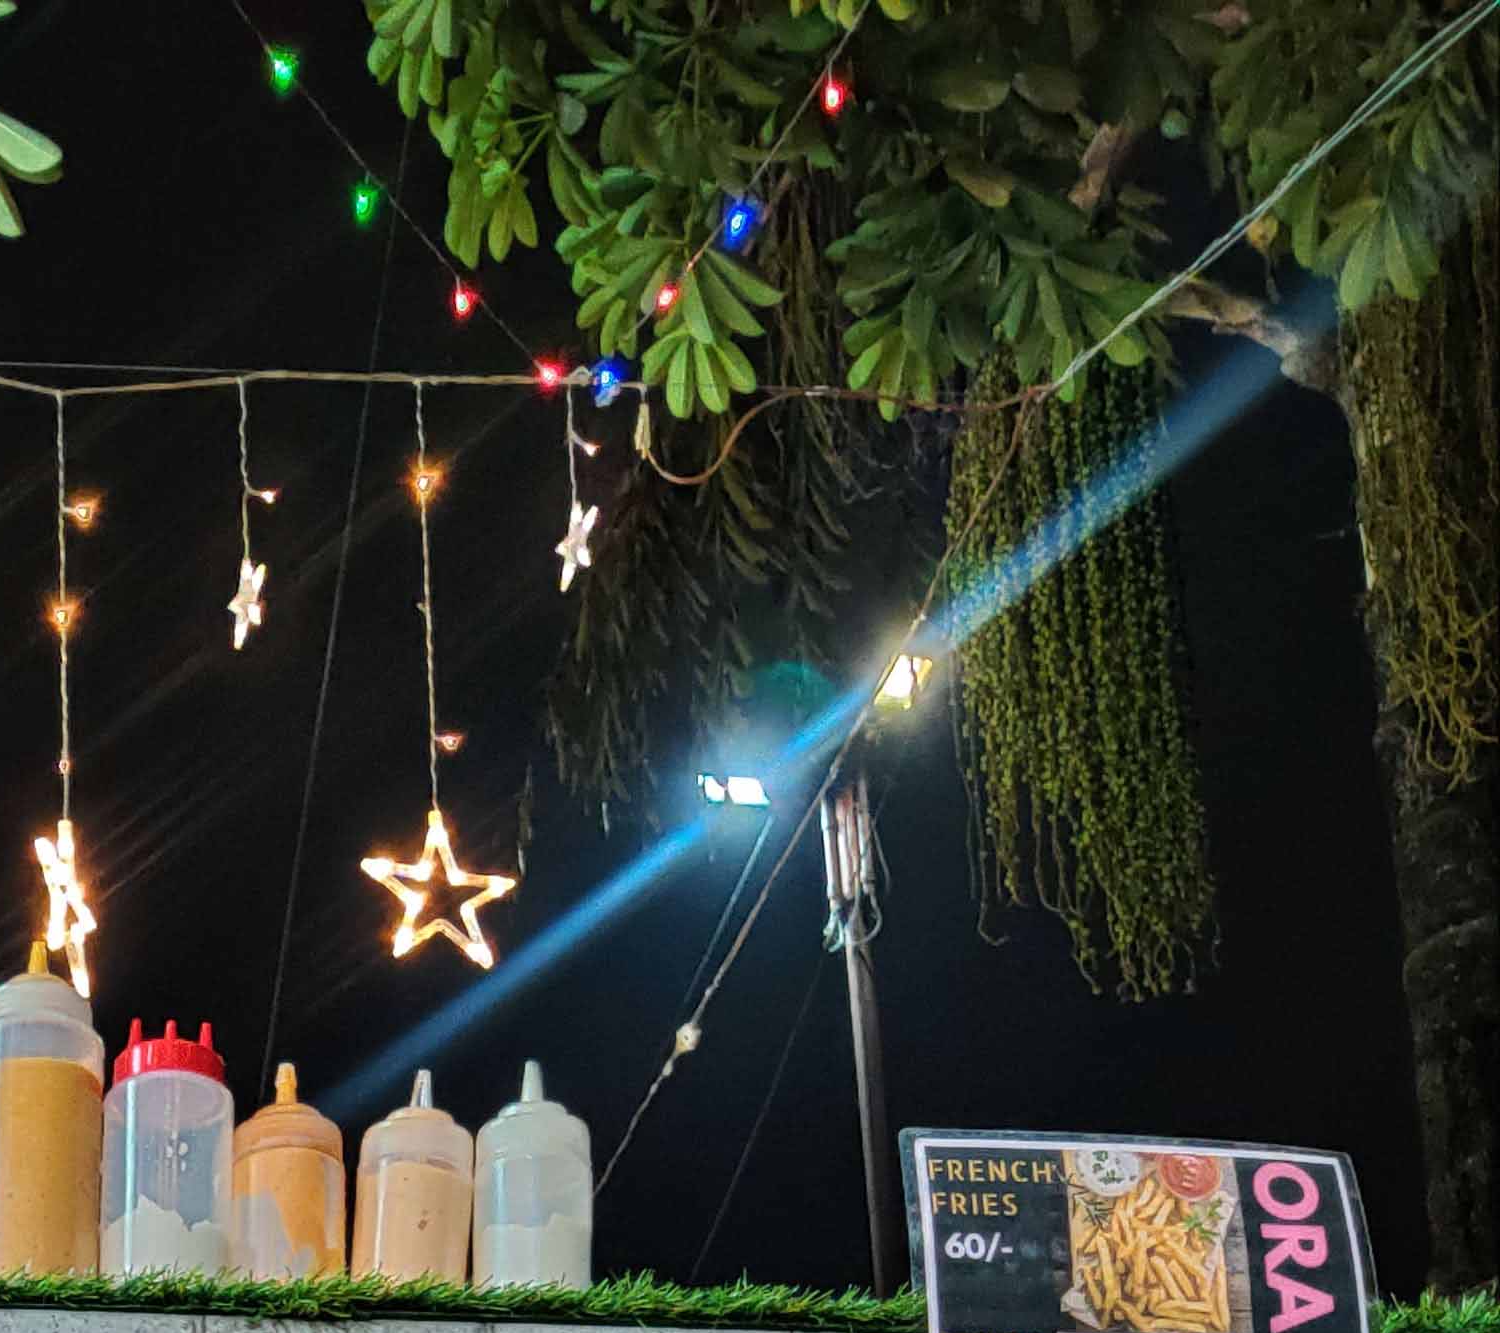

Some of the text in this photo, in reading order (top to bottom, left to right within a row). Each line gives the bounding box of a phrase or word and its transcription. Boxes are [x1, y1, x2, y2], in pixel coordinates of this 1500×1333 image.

[928, 1158, 1051, 1184] FRENCH
[931, 1192, 1019, 1217] FRIES
[944, 1231, 1014, 1263] 60/-
